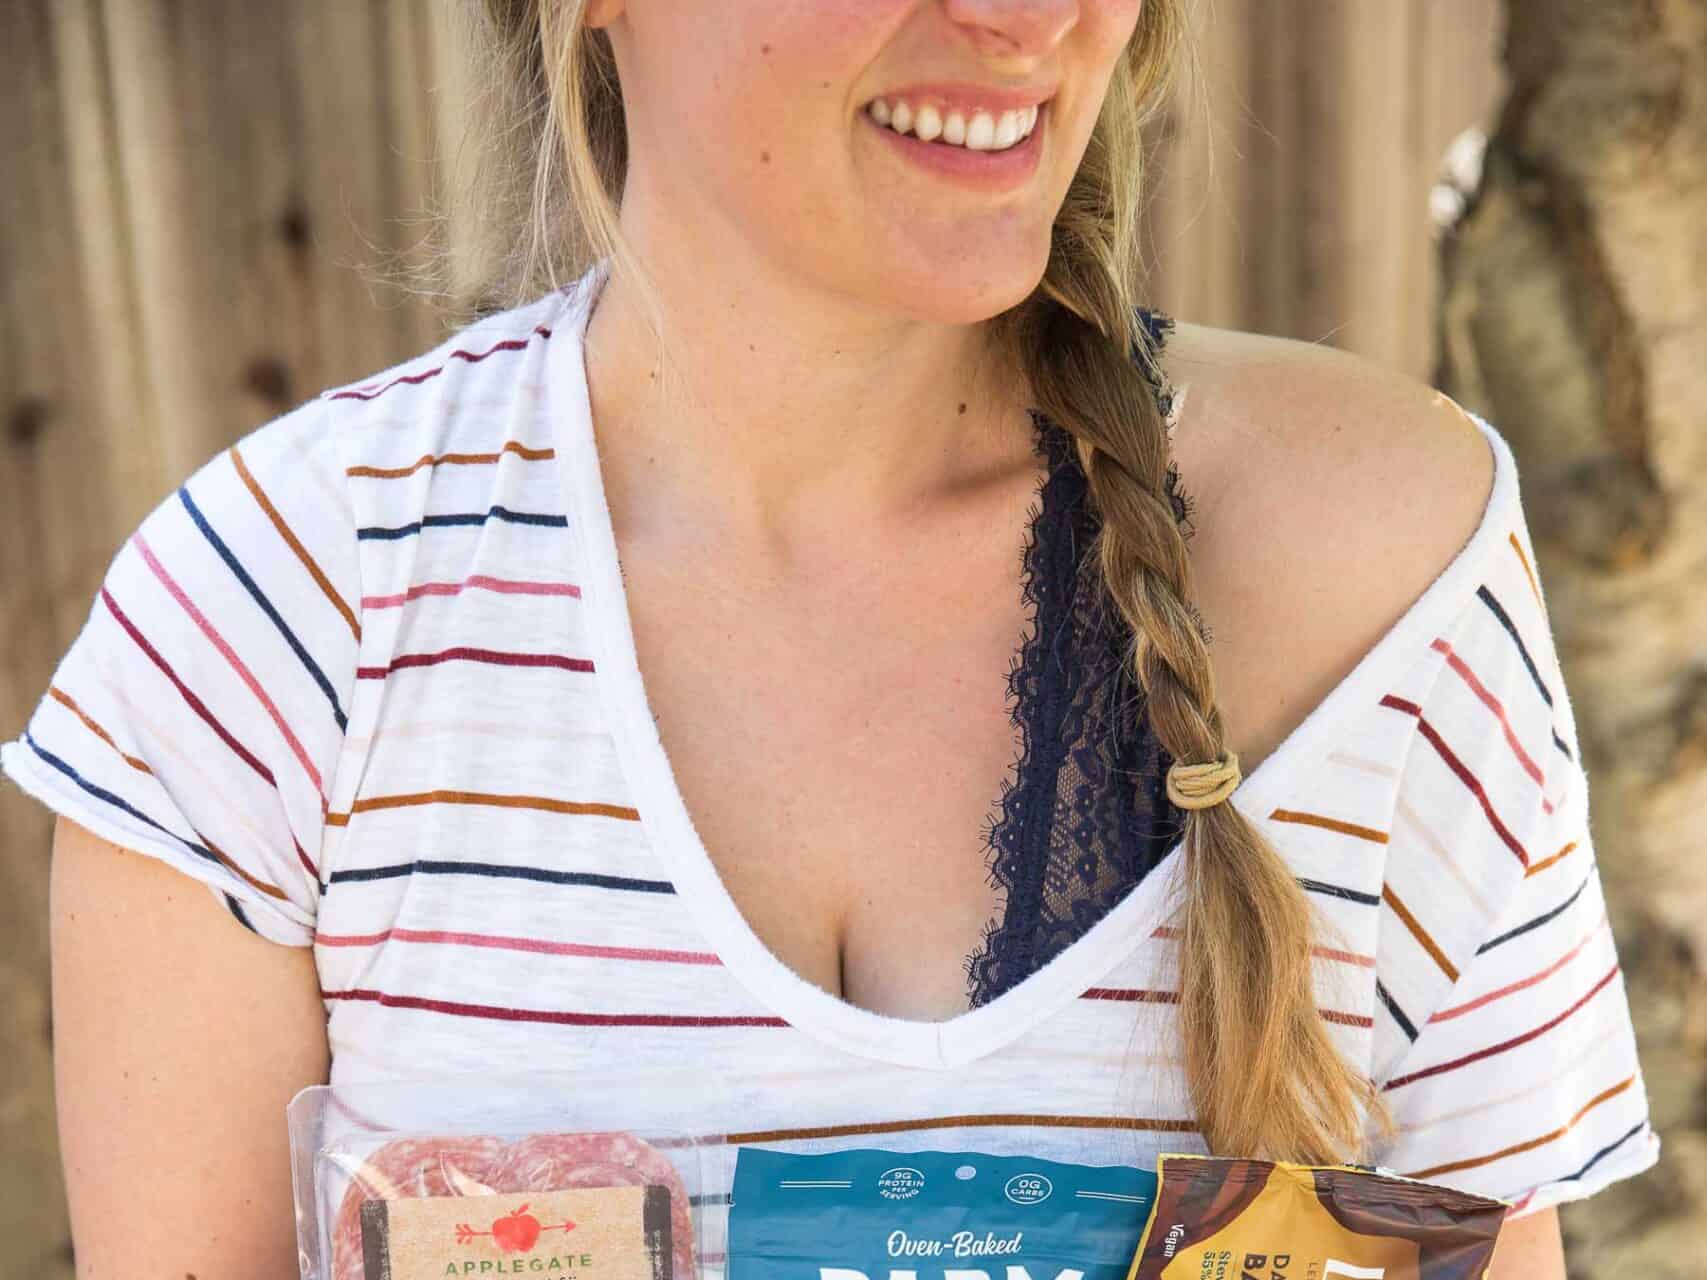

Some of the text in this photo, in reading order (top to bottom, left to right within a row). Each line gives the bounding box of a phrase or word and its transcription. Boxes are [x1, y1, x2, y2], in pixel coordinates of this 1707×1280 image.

[878, 1180, 925, 1188] PROTEIN
[880, 1189, 920, 1200] SERVING
[1010, 1189, 1045, 1197] CARBS
[887, 1230, 1024, 1257] Oven-Baked
[1163, 1223, 1185, 1258] Vegan
[446, 1254, 593, 1276] APPLEGATE
[1200, 1250, 1216, 1280] 55%
